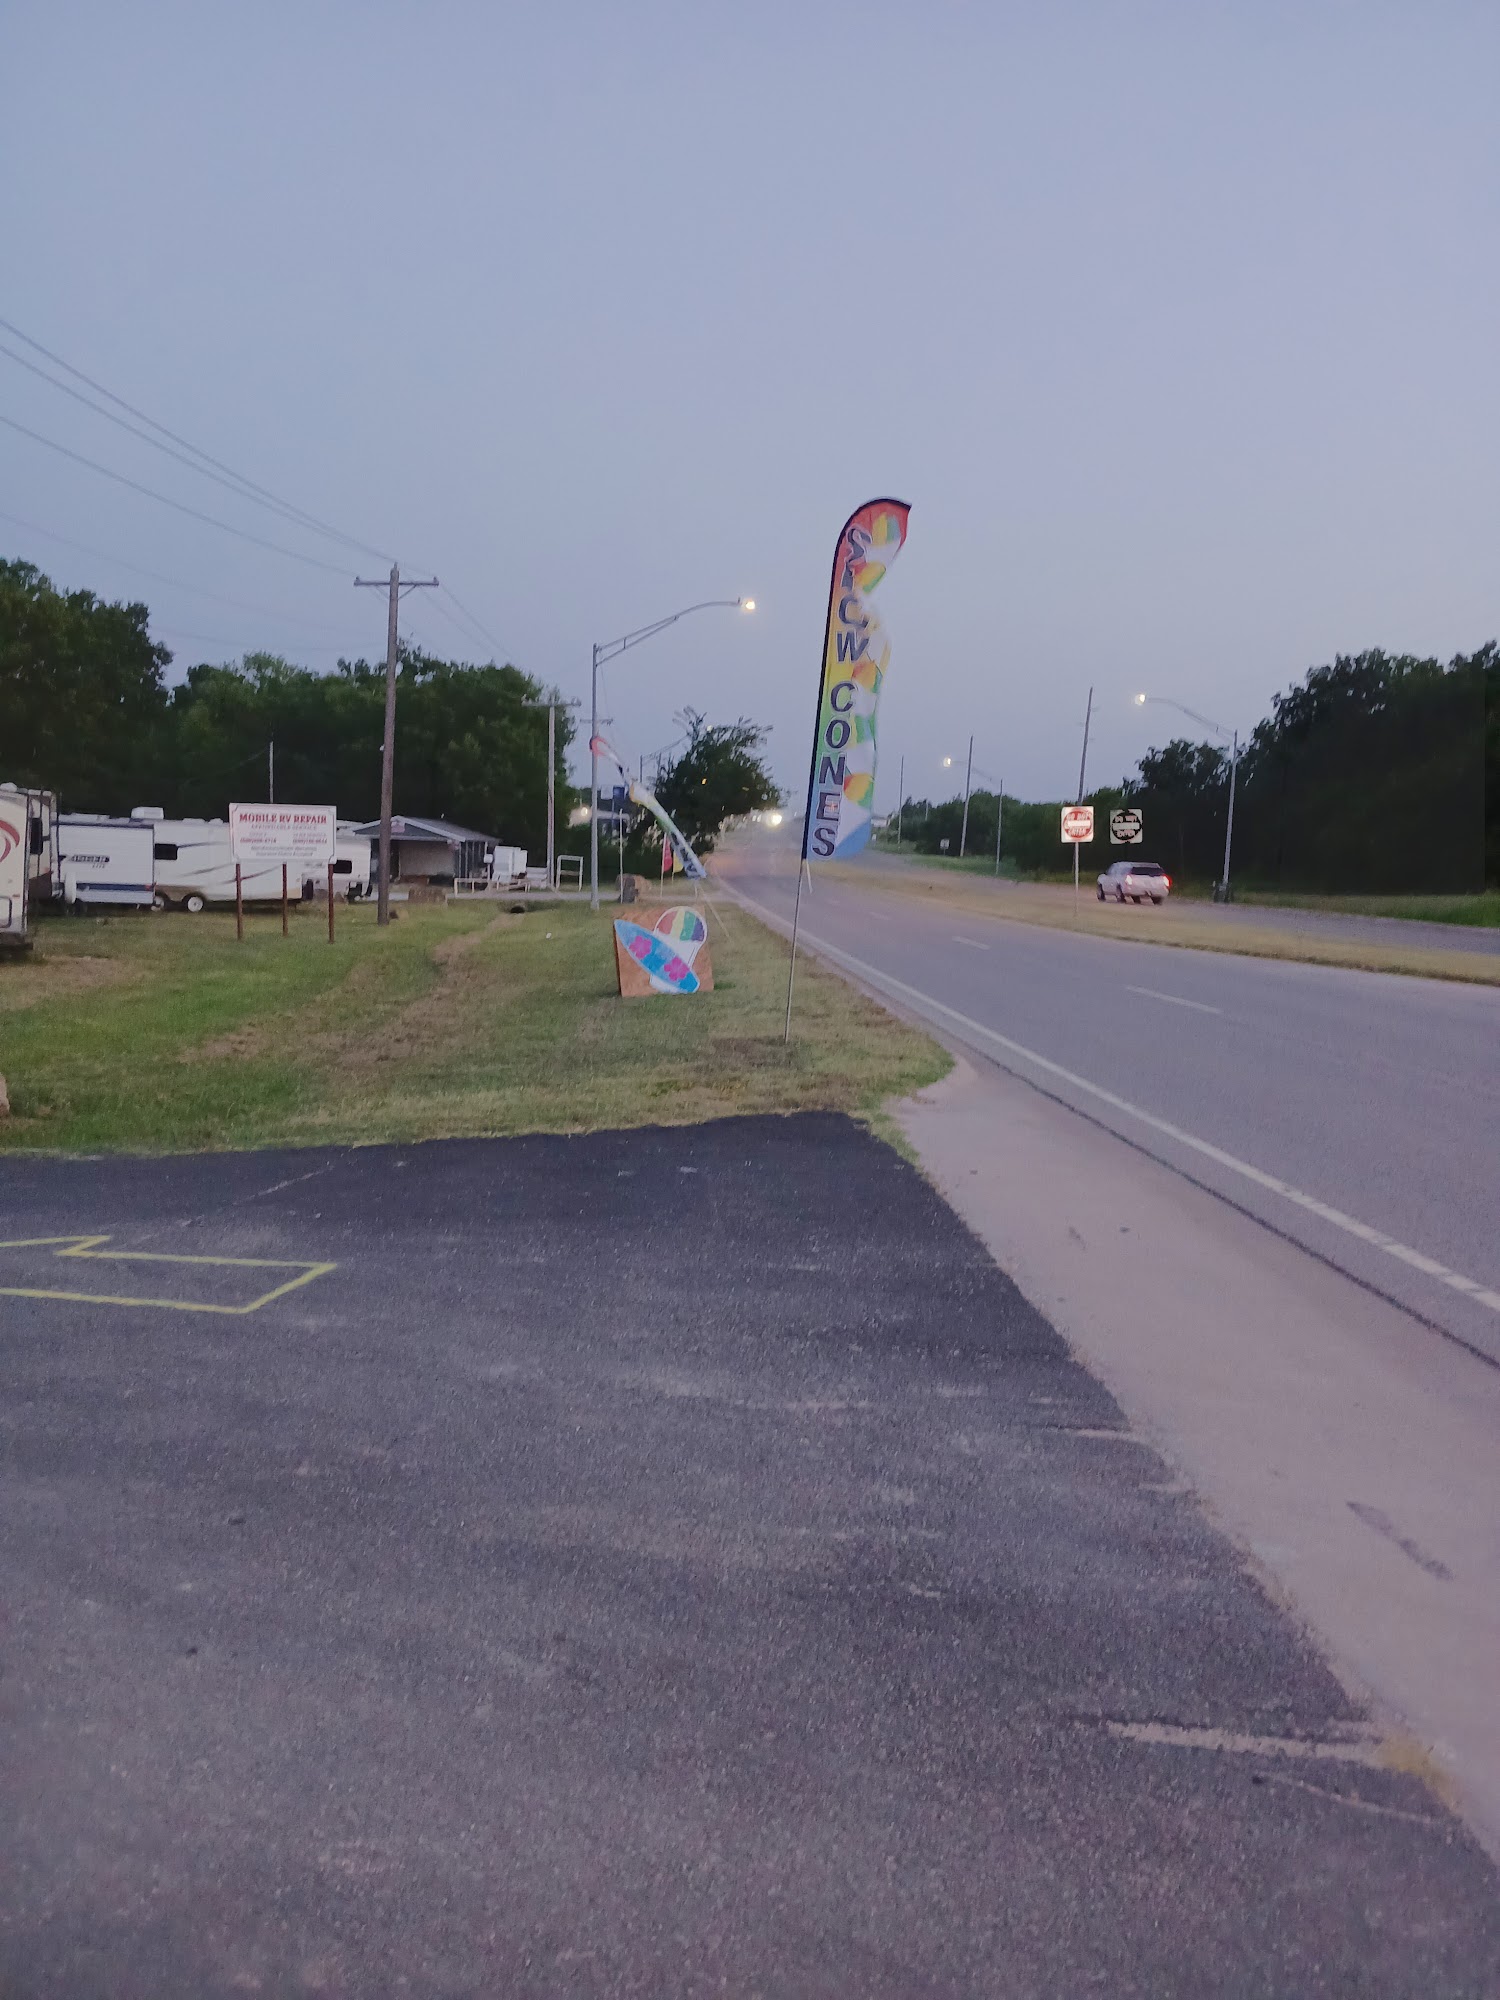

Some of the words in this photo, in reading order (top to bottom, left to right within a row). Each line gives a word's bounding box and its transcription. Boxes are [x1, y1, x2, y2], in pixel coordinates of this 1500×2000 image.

[811, 681, 856, 858] CONES
[239, 813, 277, 823] MOBILE
[279, 814, 292, 823] RV
[293, 814, 327, 824] REPAIR
